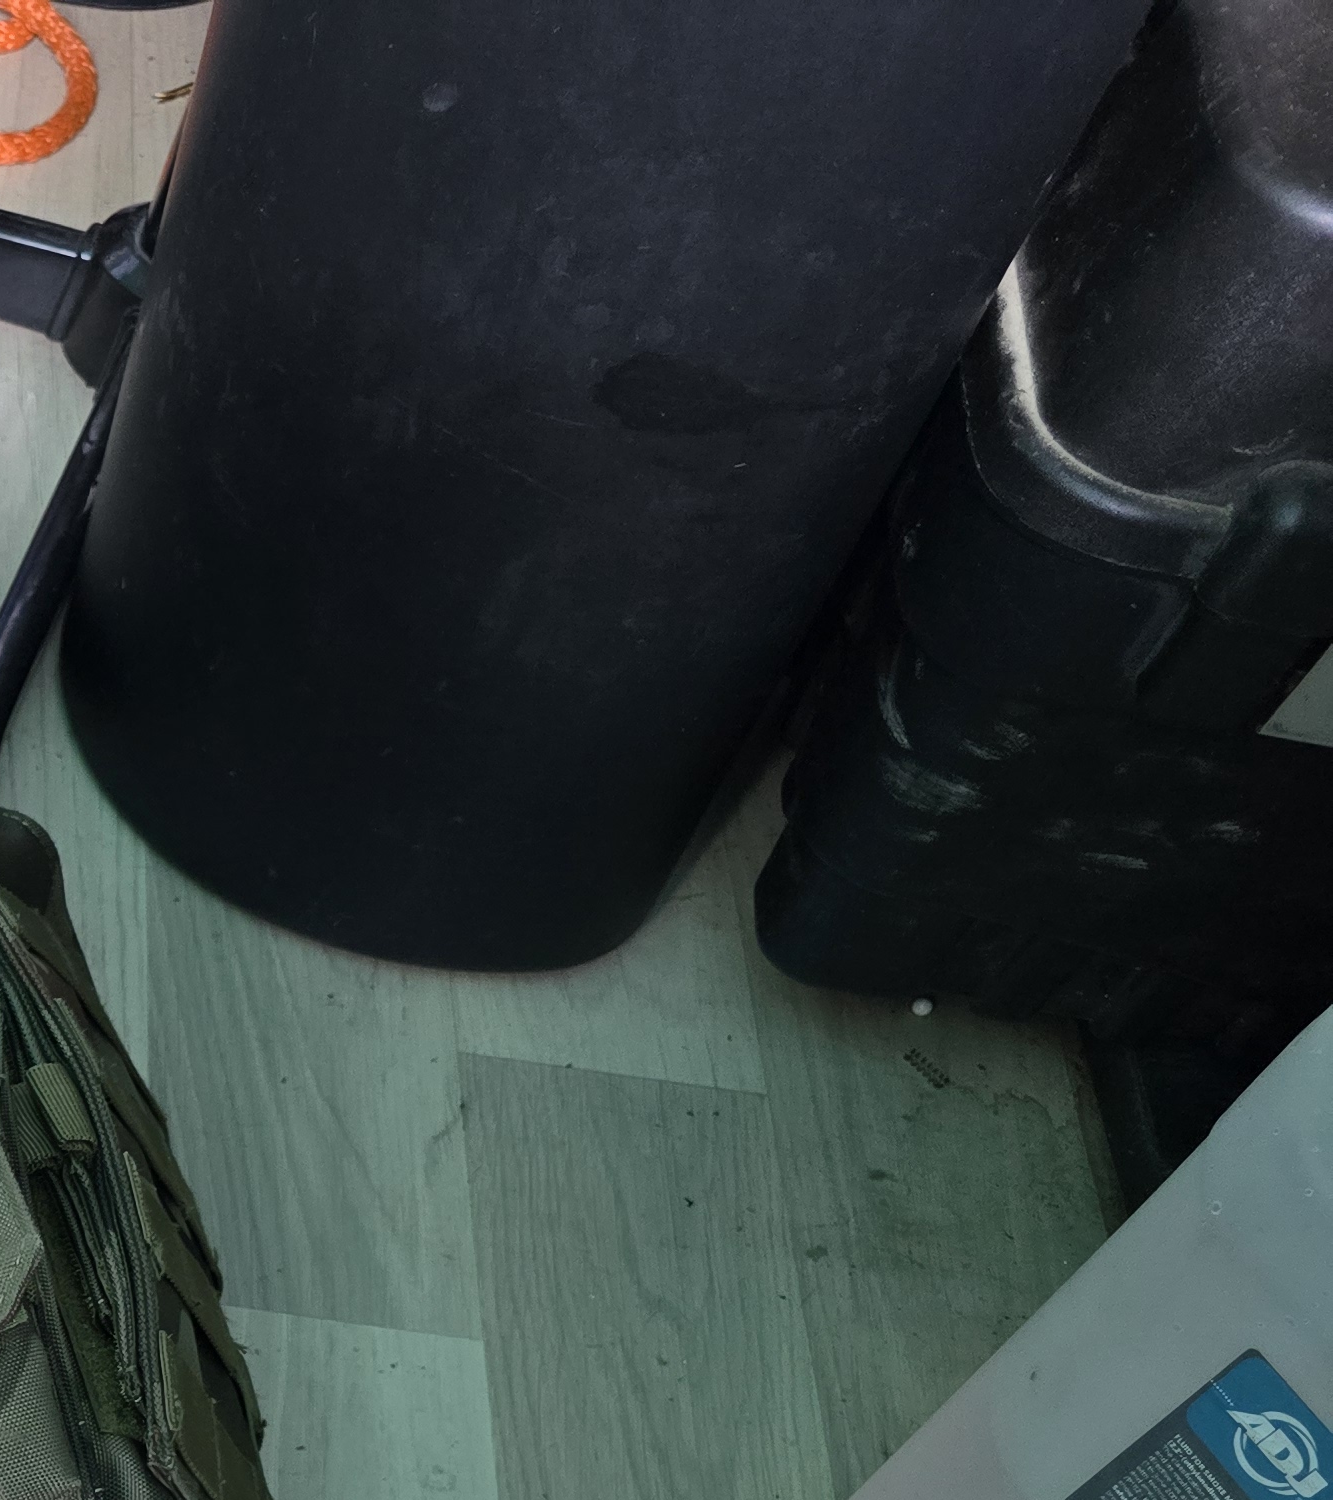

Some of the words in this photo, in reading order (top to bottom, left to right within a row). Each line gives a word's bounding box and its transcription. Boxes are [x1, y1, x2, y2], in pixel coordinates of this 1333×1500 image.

[1190, 1453, 1206, 1471] FOR
[1201, 1467, 1227, 1496] SMOKE
[1225, 1410, 1328, 1500] ADJ
